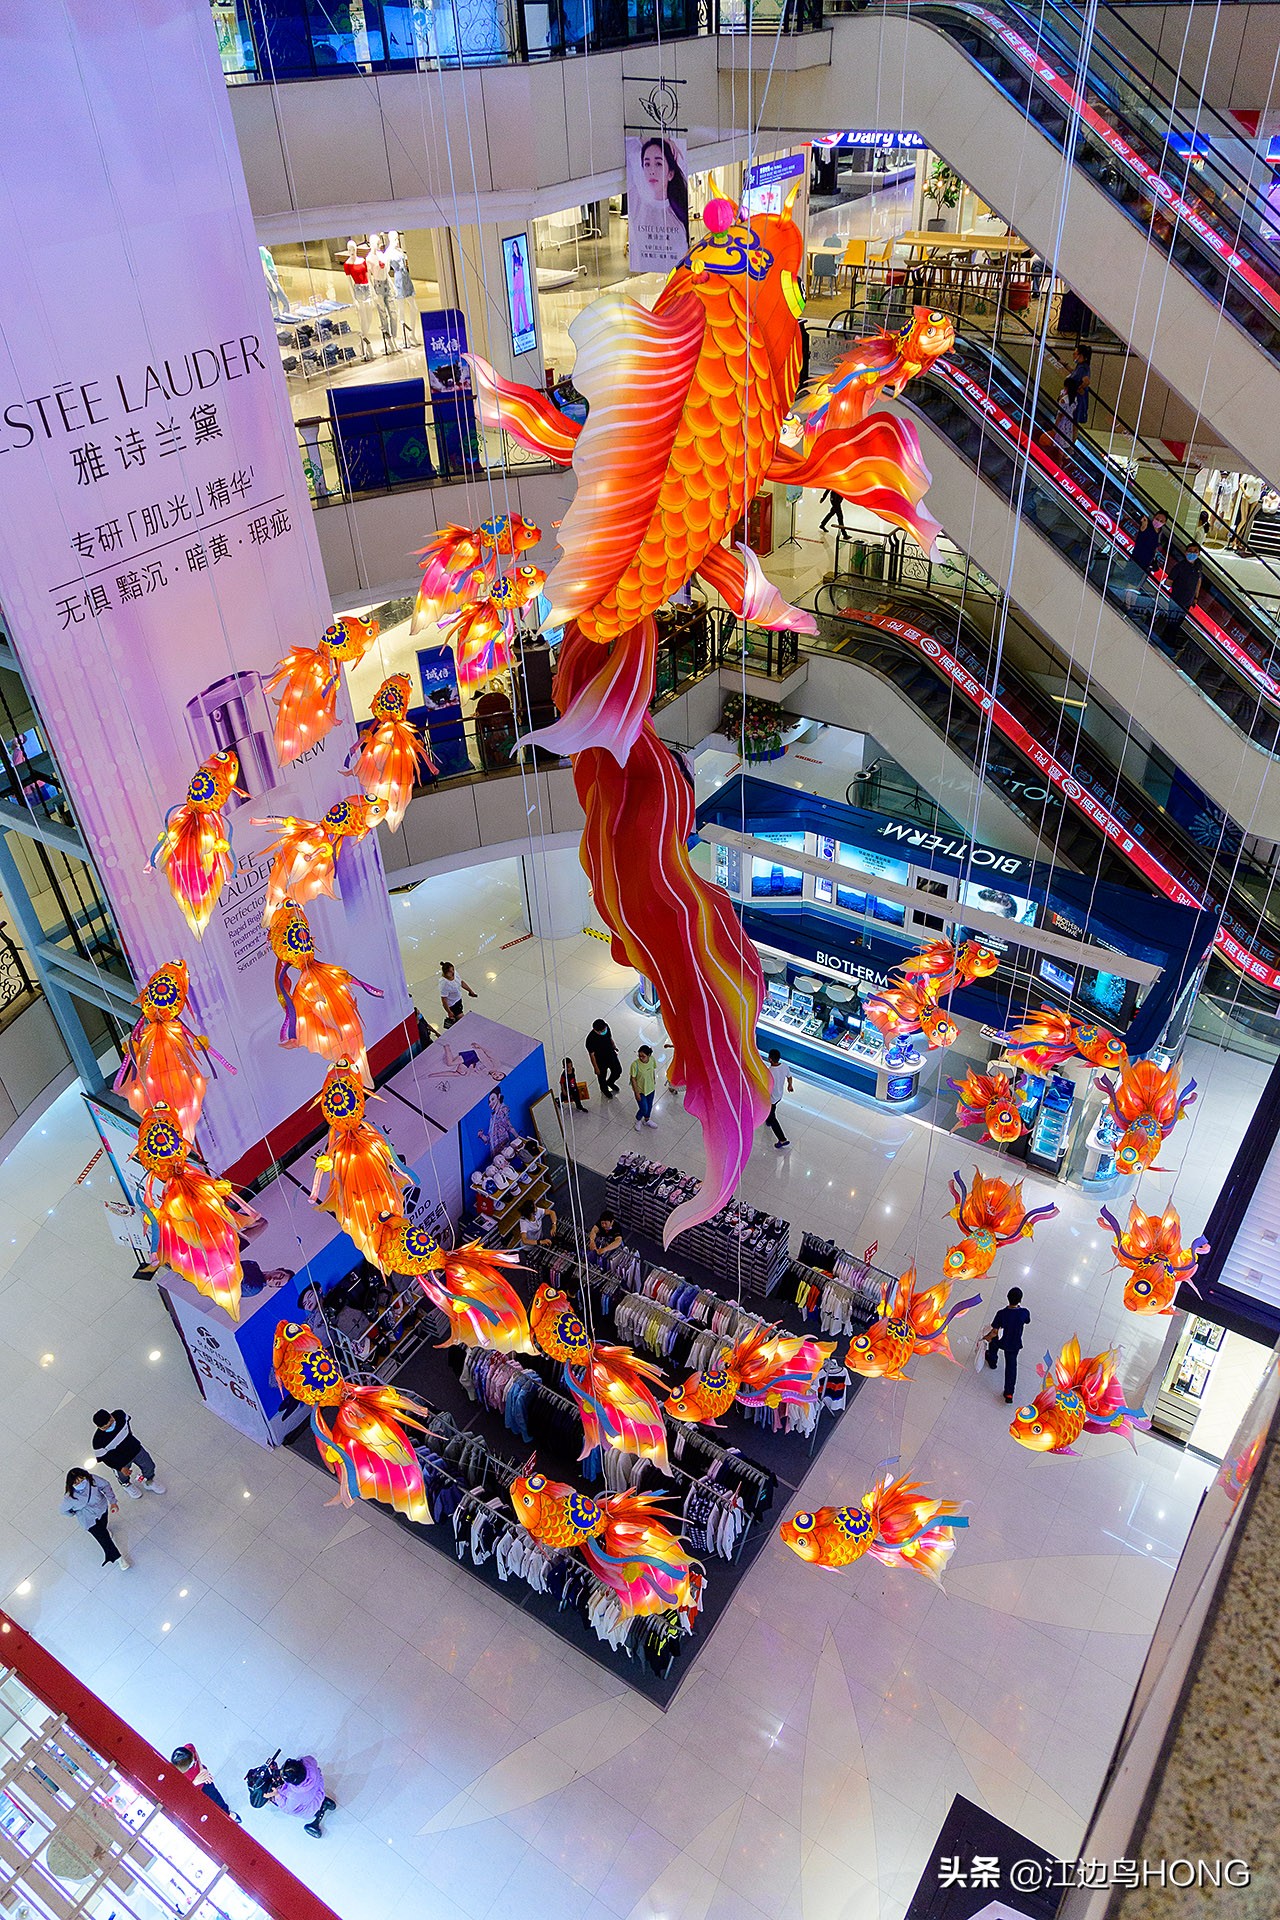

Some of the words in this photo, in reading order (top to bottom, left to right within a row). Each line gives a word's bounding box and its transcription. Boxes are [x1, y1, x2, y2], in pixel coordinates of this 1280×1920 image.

[847, 132, 893, 147] Dairy
[116, 334, 266, 414] LAUDER
[69, 403, 224, 487] 雅诗兰黛
[55, 584, 114, 632] 无惧
[291, 736, 326, 770] NEW
[883, 821, 1023, 875] BIOTHERM
[816, 950, 889, 988] BIOTHERM
